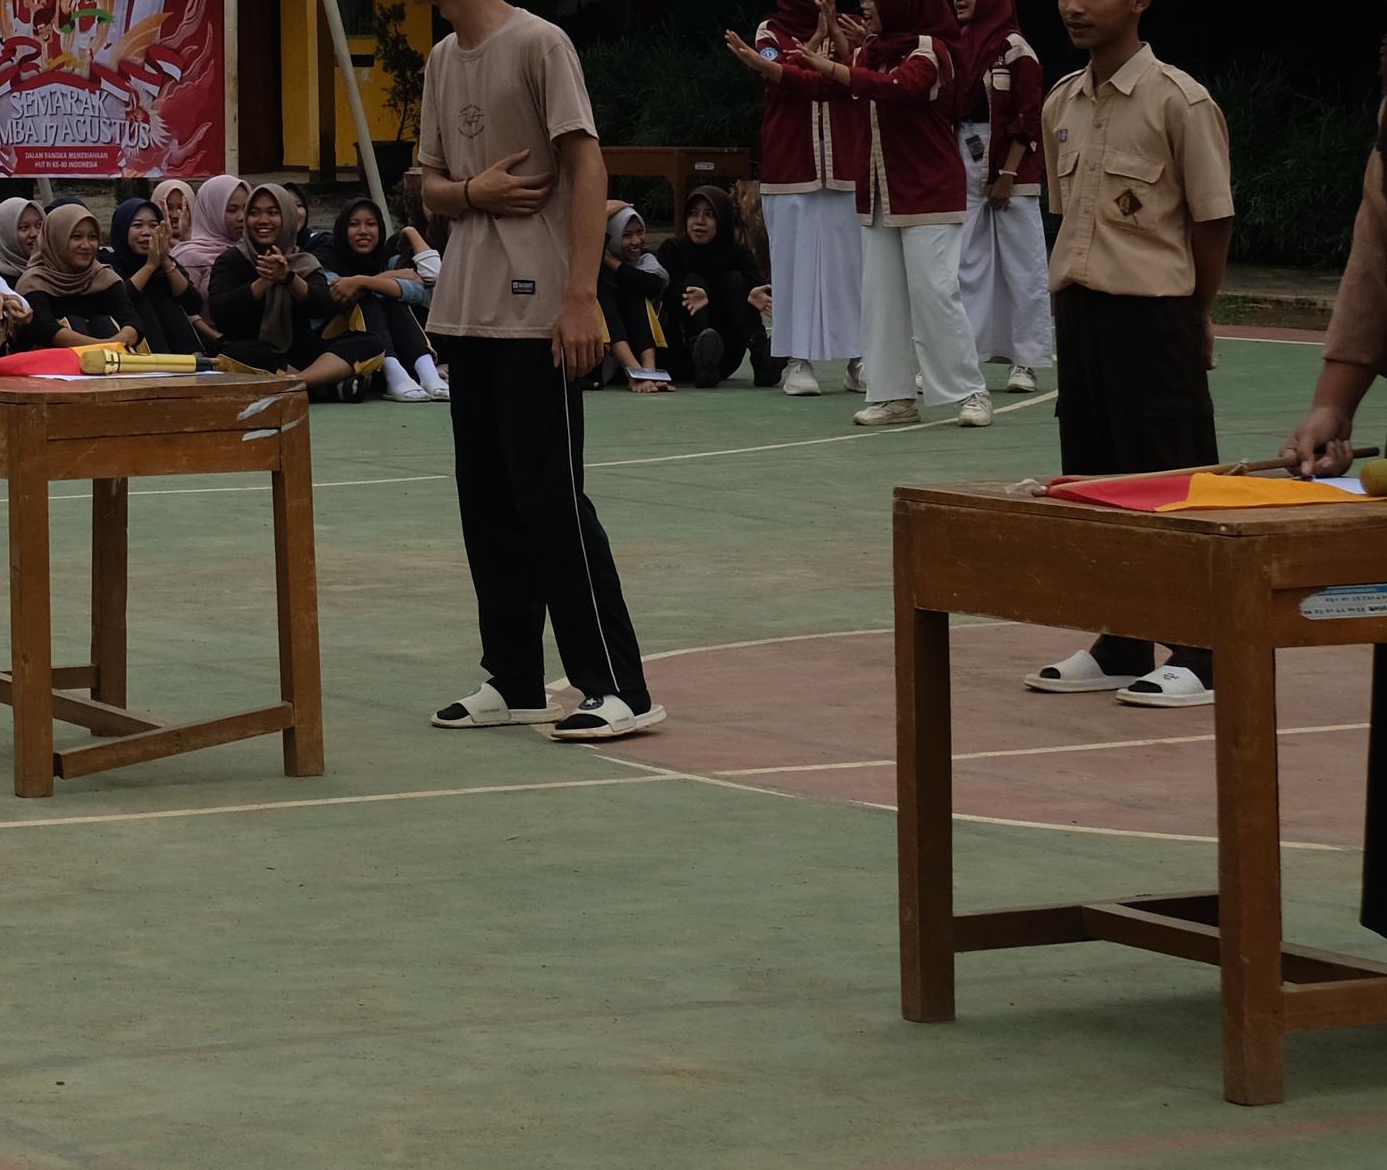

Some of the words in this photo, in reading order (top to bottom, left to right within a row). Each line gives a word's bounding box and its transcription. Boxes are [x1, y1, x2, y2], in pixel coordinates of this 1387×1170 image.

[9, 89, 109, 120] SEMARAK
[42, 122, 59, 146] 17
[61, 116, 151, 149] AGUSTUS
[25, 151, 44, 159] DALAM
